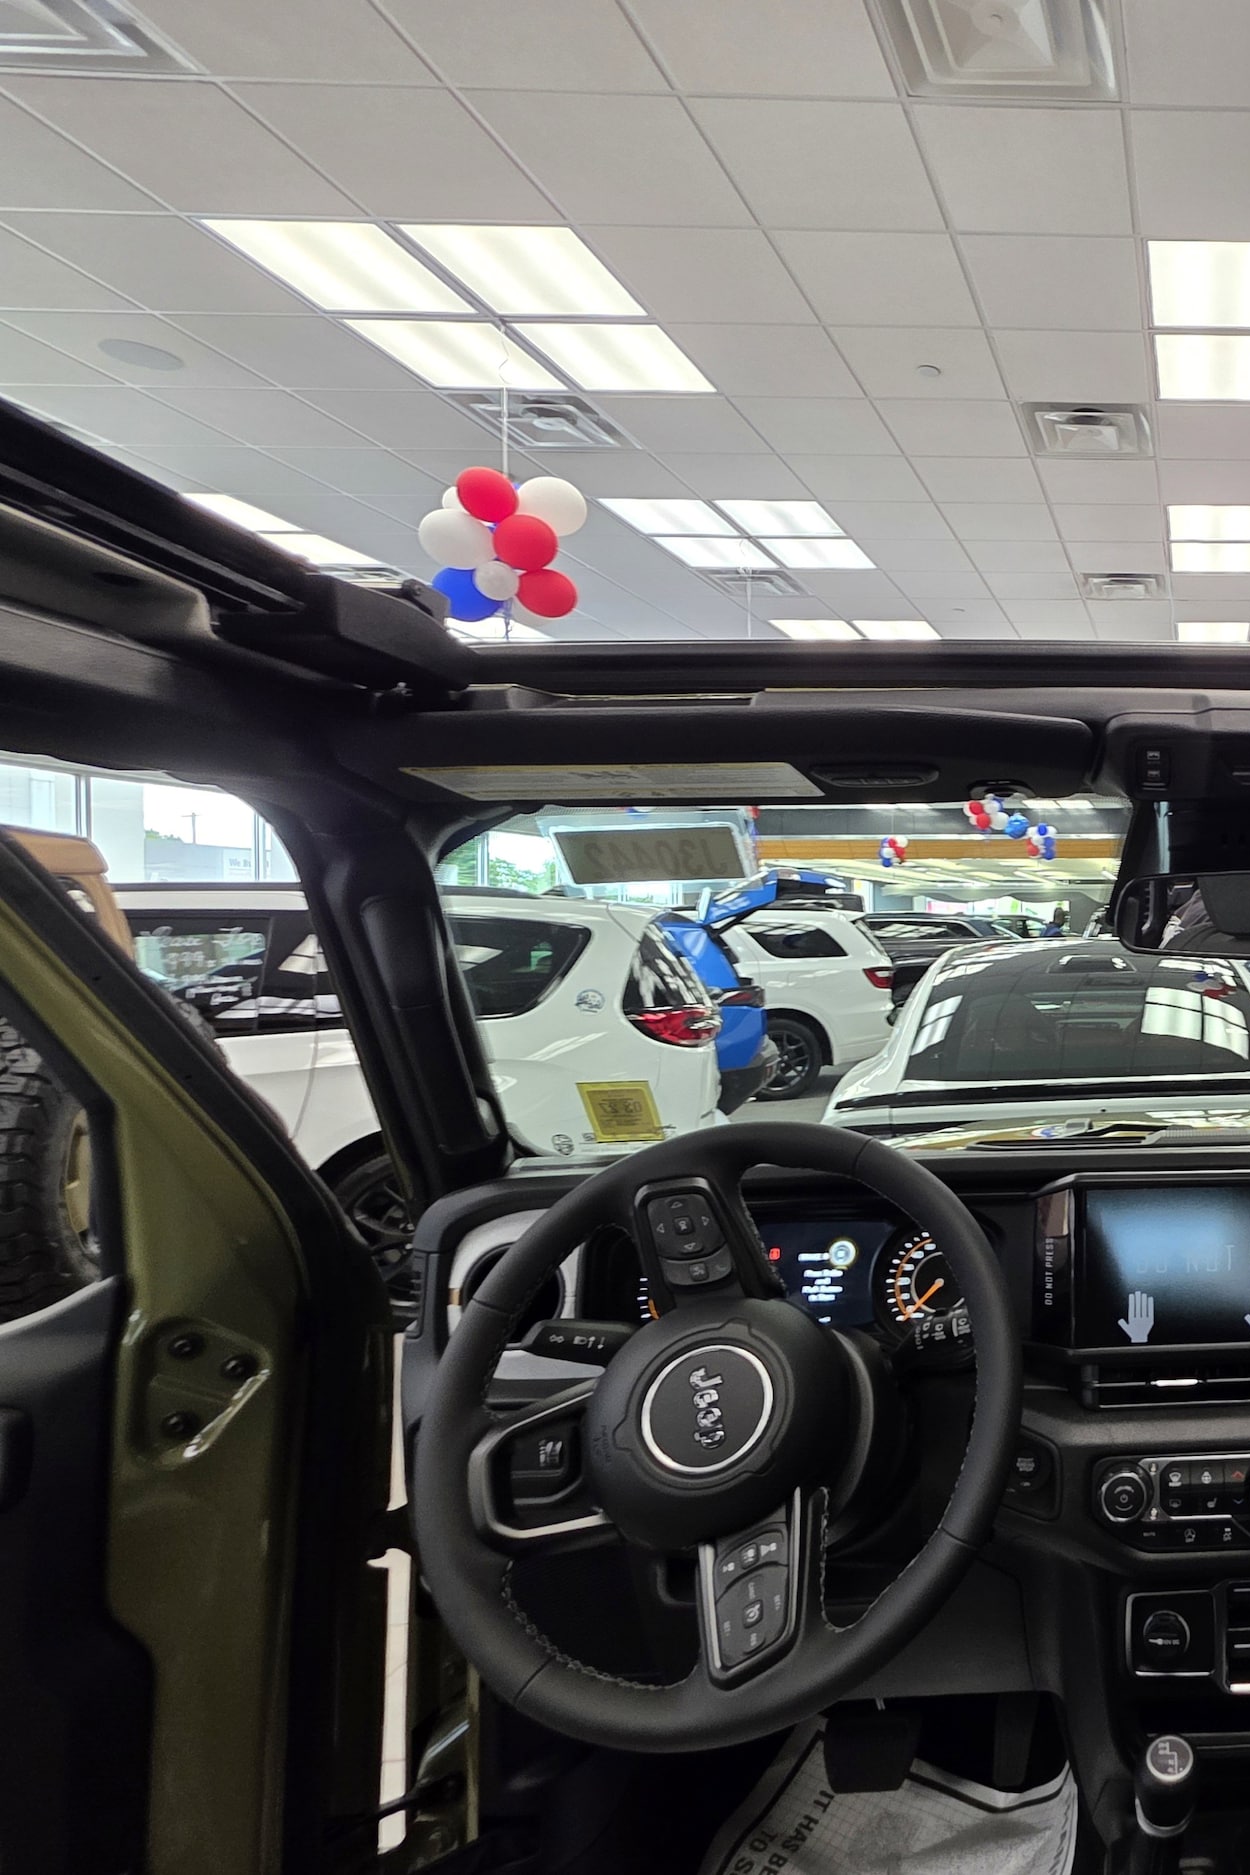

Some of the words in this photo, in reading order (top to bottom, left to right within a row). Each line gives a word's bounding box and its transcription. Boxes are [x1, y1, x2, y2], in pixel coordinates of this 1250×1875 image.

[1045, 1237, 1054, 1268] PRESS
[1044, 1271, 1053, 1290] NOT
[1044, 1292, 1053, 1306] DO
[812, 1790, 836, 1812] IT
[751, 1829, 776, 1853] TO
[787, 1815, 819, 1852] HAS
